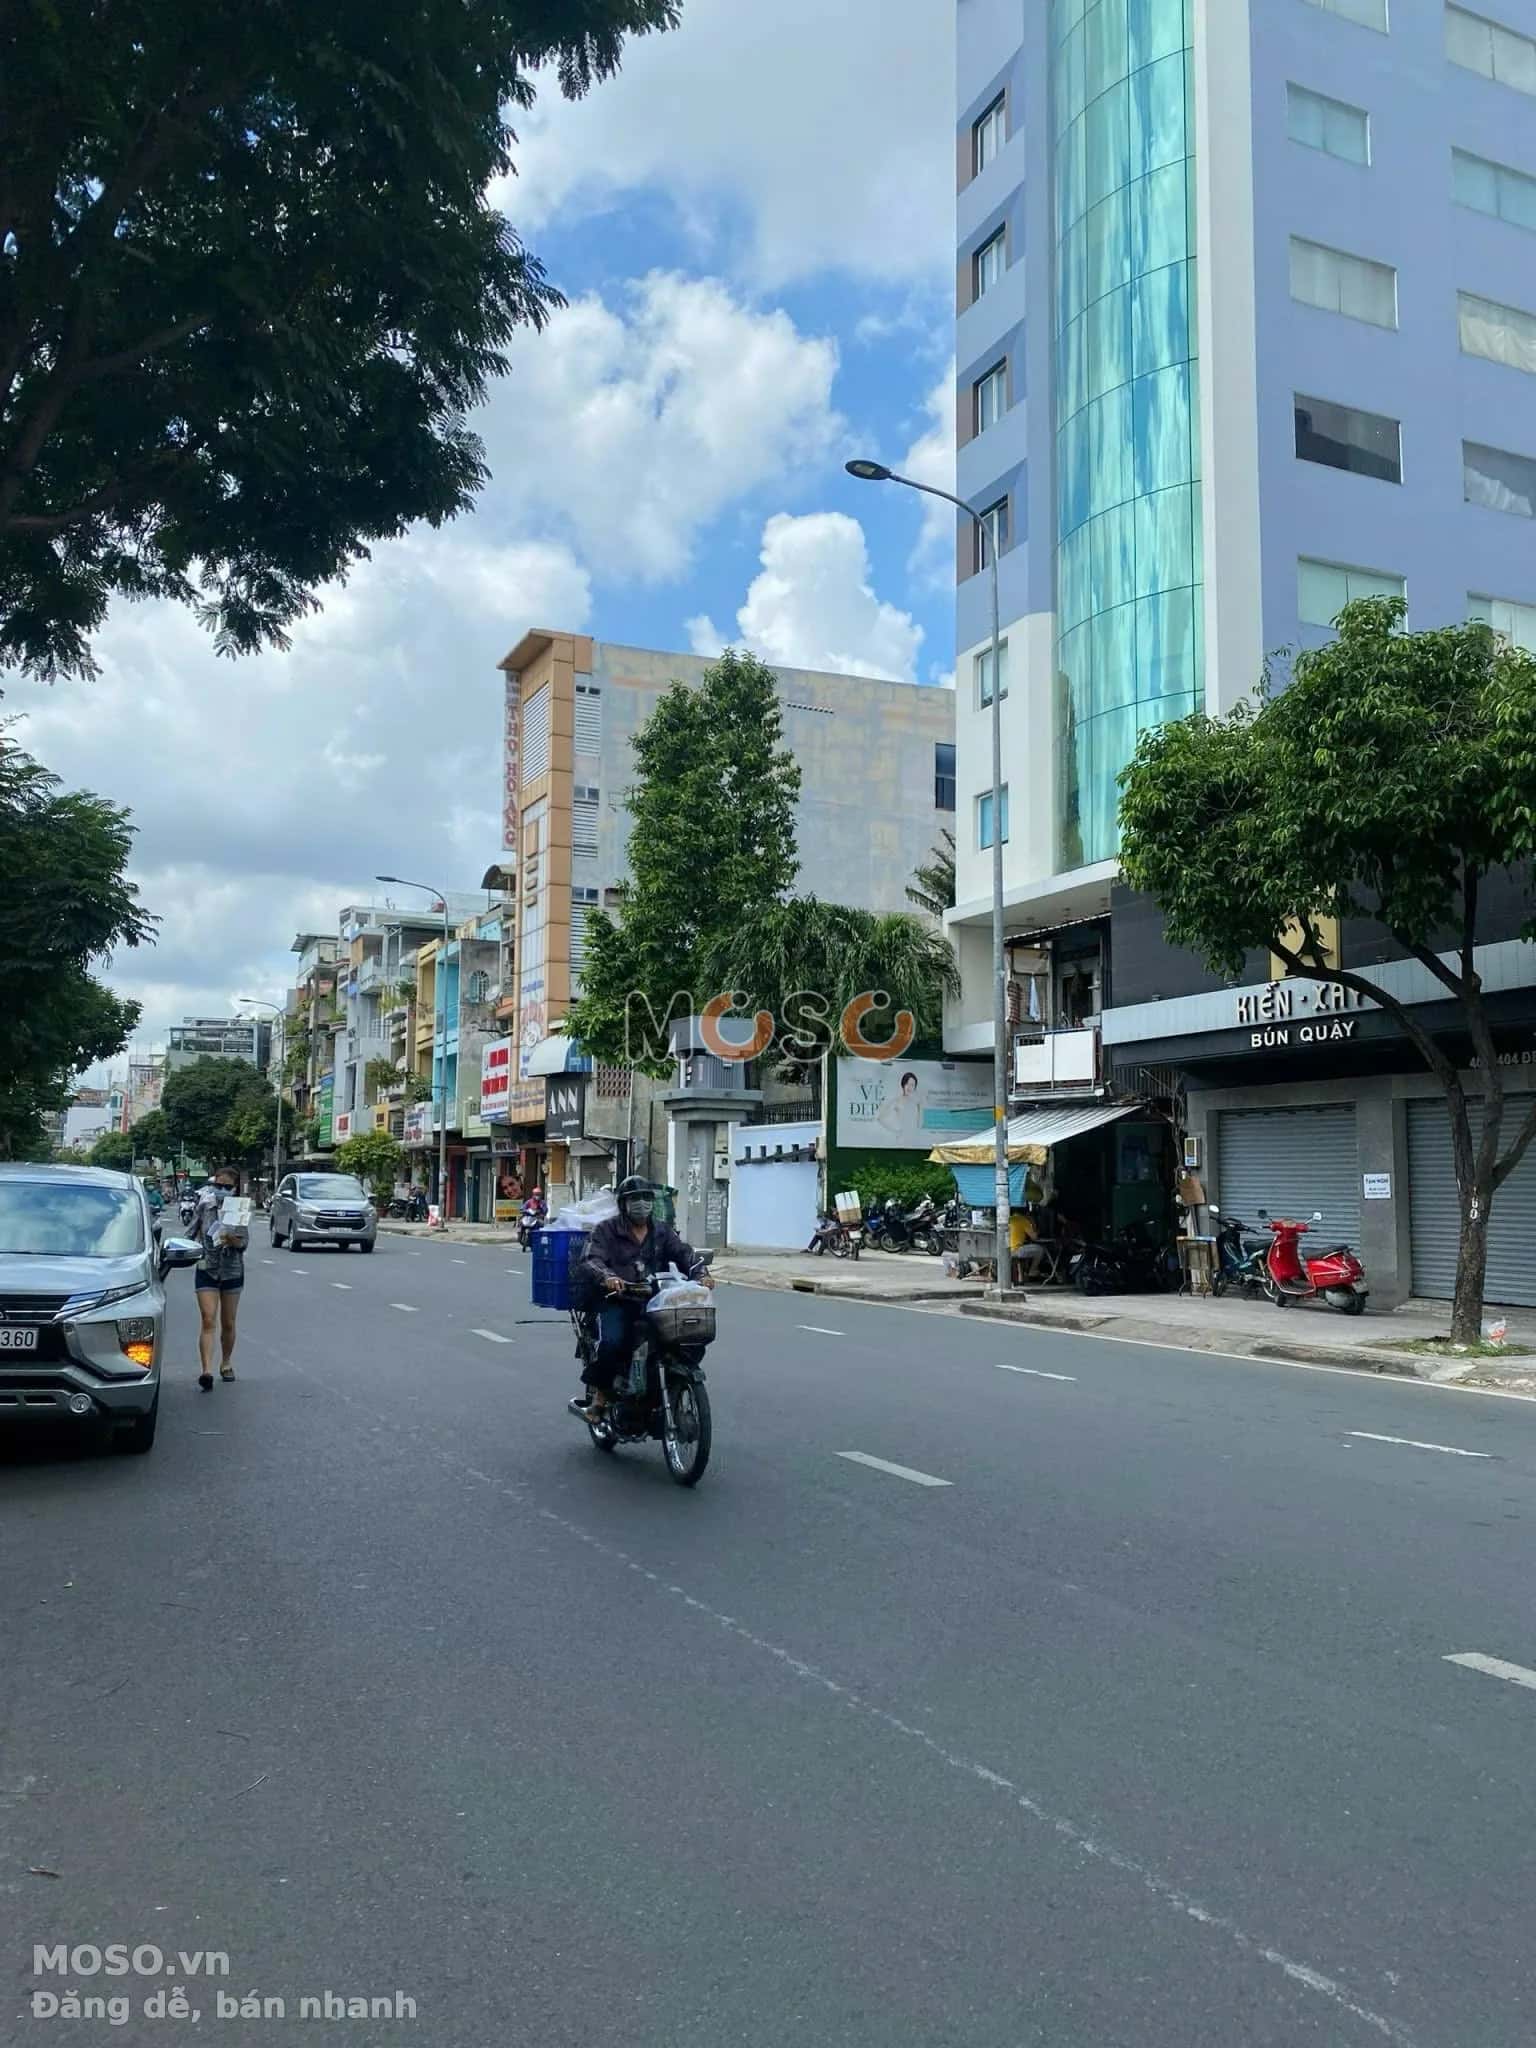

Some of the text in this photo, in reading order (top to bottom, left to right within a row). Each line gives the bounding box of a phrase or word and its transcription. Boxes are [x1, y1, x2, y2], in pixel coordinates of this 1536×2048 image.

[1251, 1019, 1354, 1048] BÚN QUẬY
[548, 1087, 578, 1115] ANN
